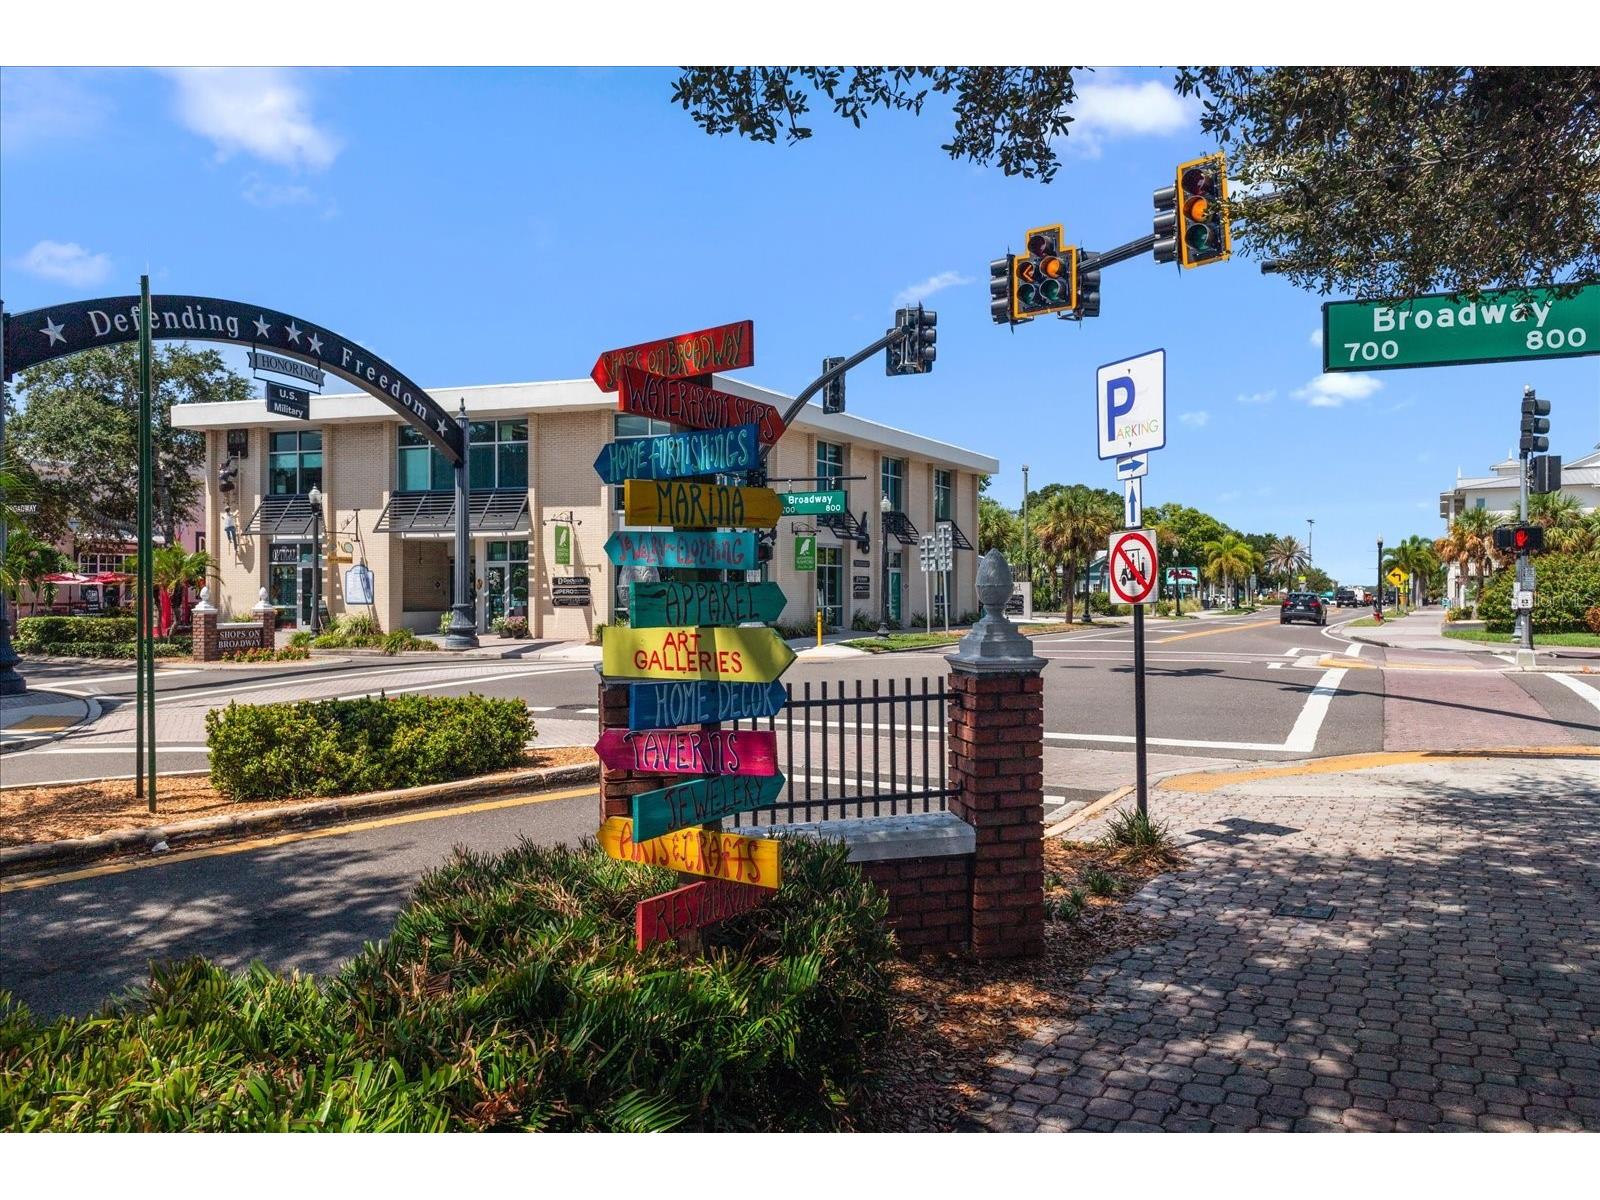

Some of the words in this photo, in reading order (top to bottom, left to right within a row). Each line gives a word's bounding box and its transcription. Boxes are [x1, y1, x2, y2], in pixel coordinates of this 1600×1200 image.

[1373, 300, 1552, 333] Broadway
[1344, 340, 1399, 362] 700
[1526, 327, 1587, 350] 800
[87, 304, 239, 339] Defending
[341, 346, 428, 421] Freedom
[261, 355, 319, 381] HONORING
[279, 388, 298, 401] U.S.
[273, 403, 303, 418] Military
[609, 440, 648, 481] HOME
[783, 506, 796, 514] 00
[825, 504, 841, 512] 800
[788, 495, 833, 505] Broadway
[665, 583, 761, 626] APPAREL
[218, 639, 261, 649] BROADWAY
[219, 630, 246, 639] SHOPS
[248, 629, 261, 638] ON
[662, 631, 702, 651] ART
[634, 650, 743, 673] GALLERIES
[654, 682, 710, 727] HOME
